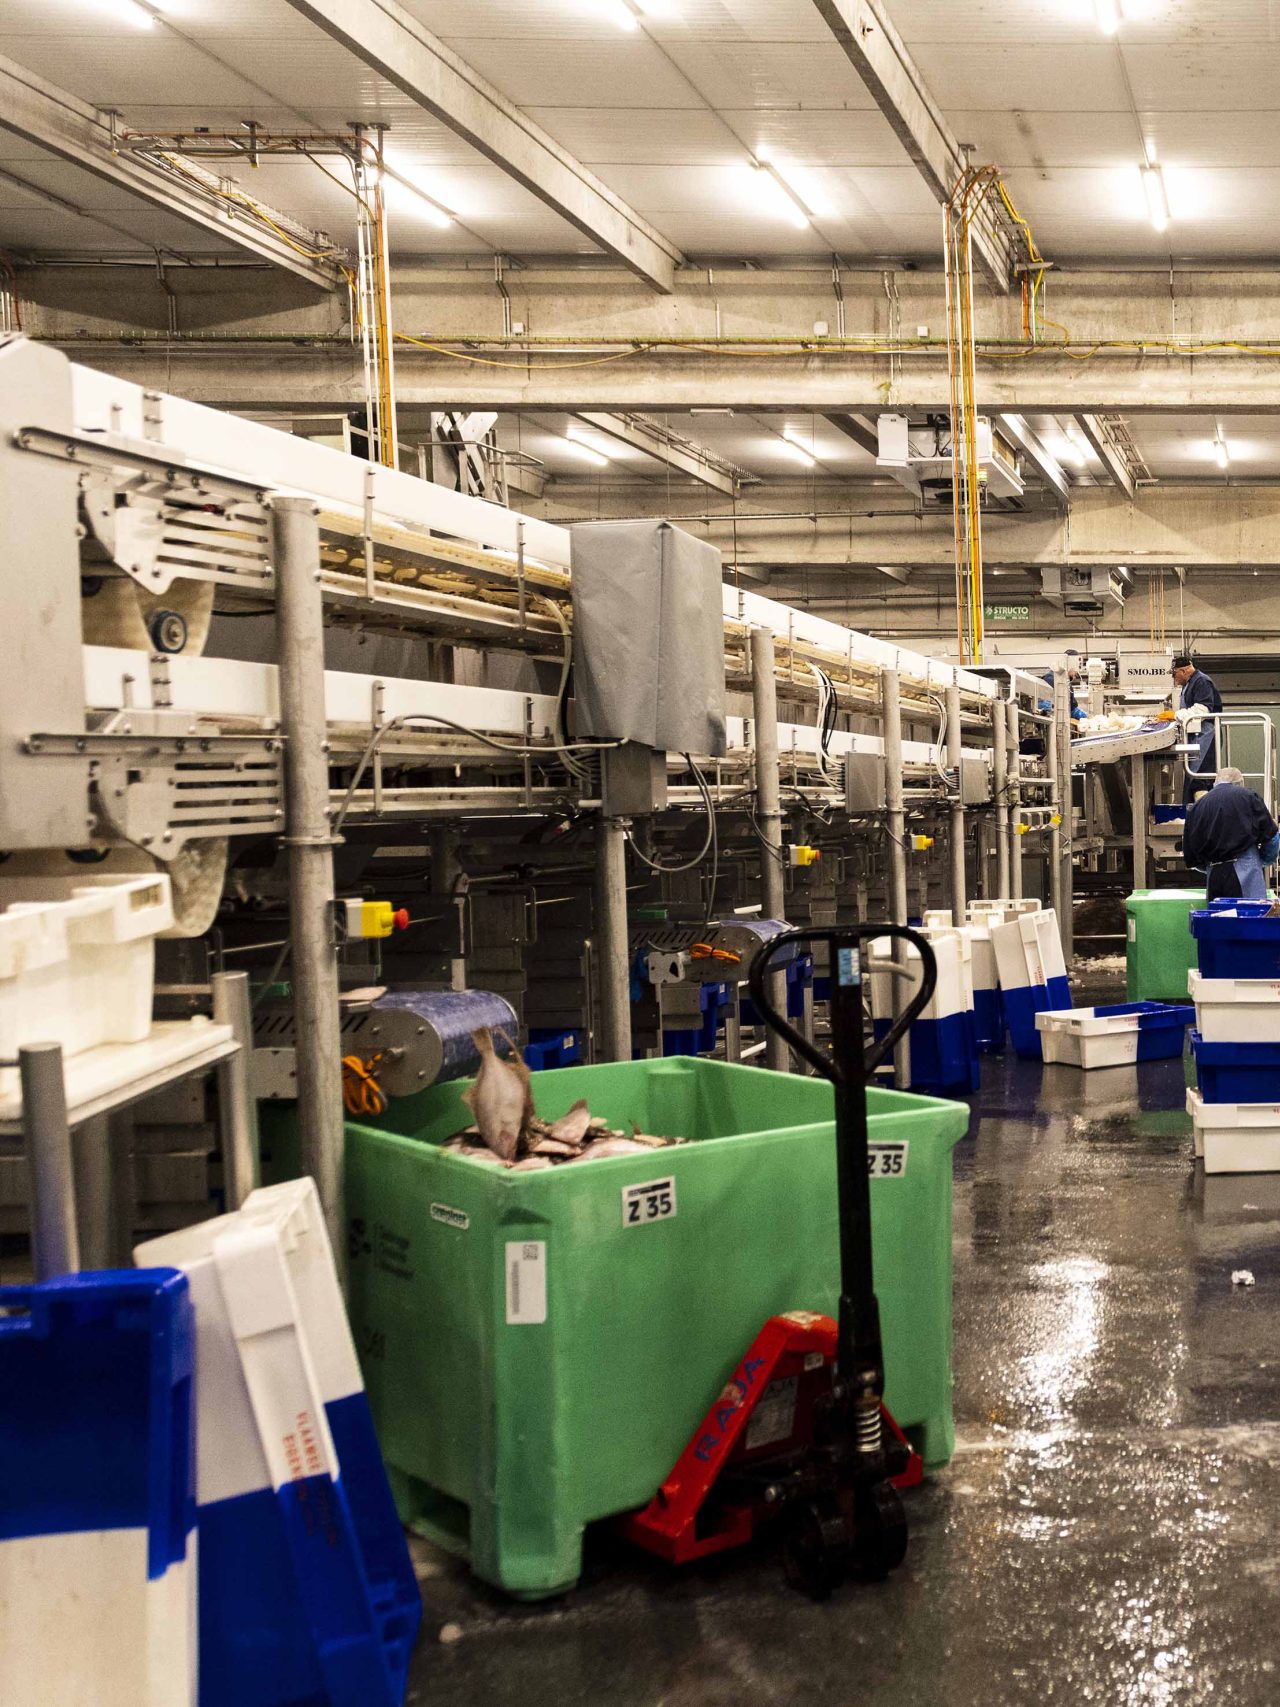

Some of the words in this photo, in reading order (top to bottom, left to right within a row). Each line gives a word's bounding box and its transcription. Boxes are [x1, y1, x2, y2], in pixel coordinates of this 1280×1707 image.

[993, 606, 1029, 615] STRUCTO
[1127, 668, 1166, 676] SMO.BE
[866, 1154, 876, 1175] Z
[880, 1153, 903, 1175] 35
[628, 1199, 640, 1223] Z
[646, 1192, 671, 1218] 35
[694, 1357, 766, 1462] RAJA
